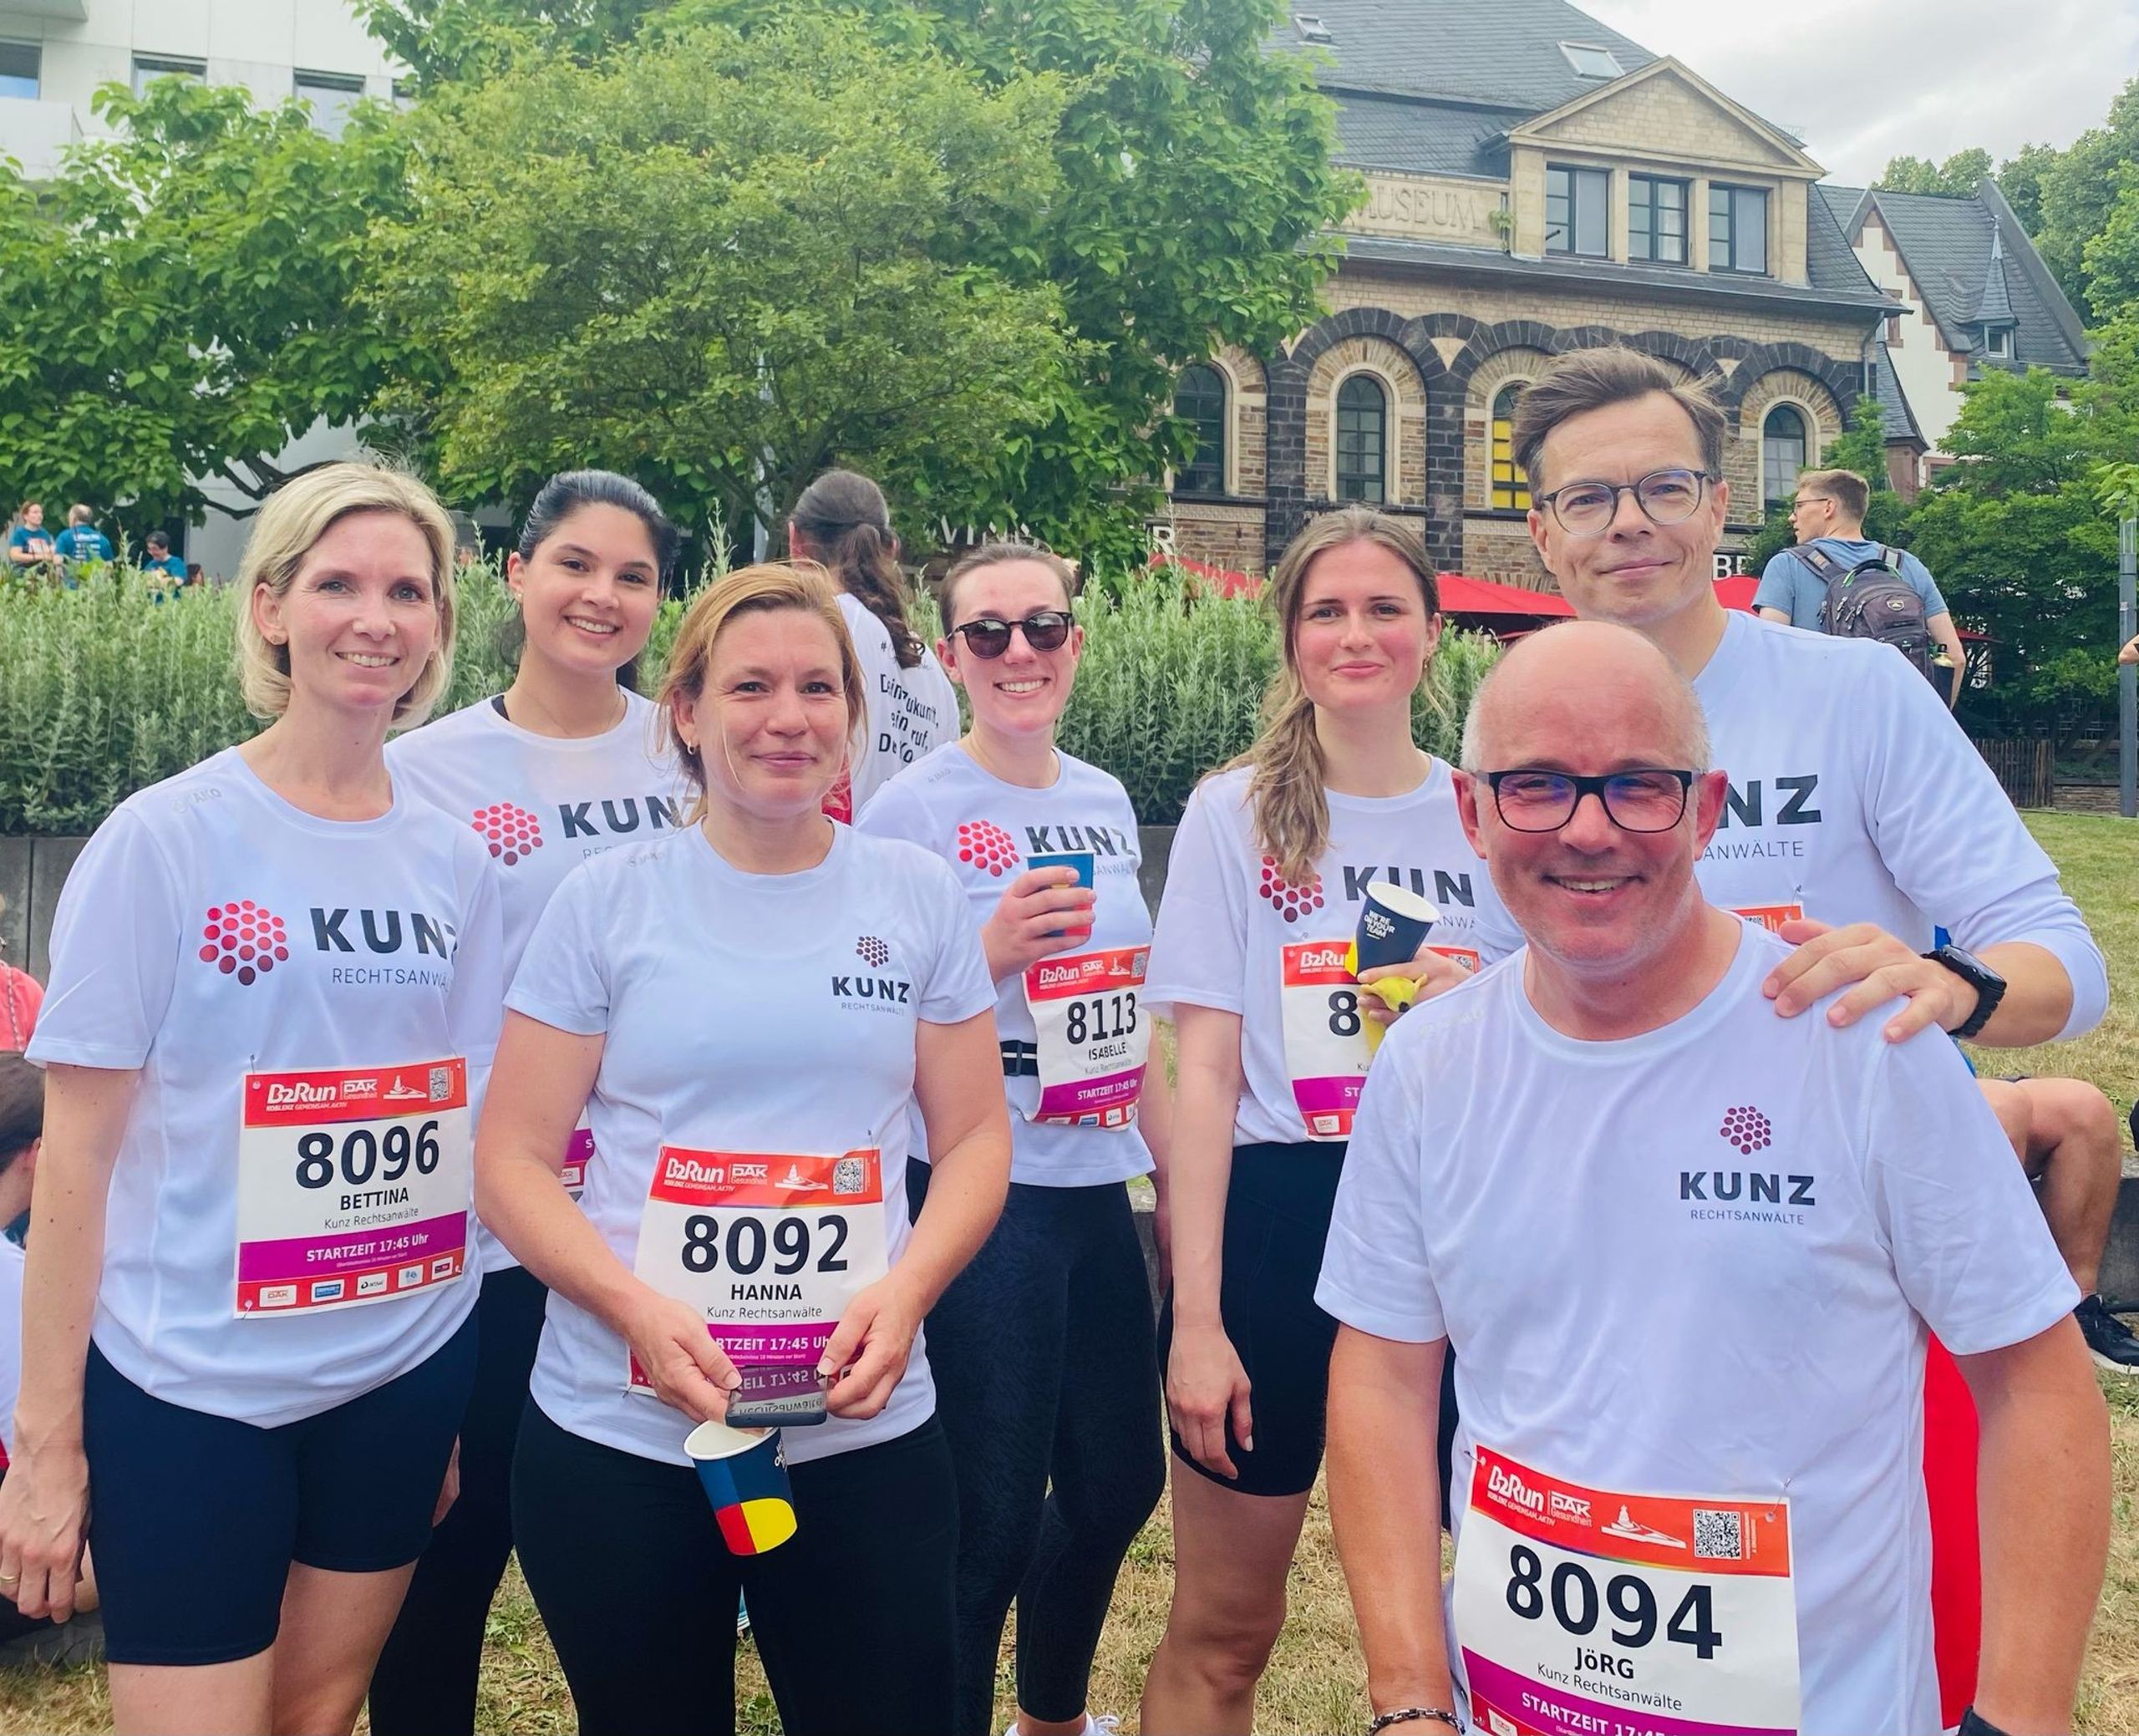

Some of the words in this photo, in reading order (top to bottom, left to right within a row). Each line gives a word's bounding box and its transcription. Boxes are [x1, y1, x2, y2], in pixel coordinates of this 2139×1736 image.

[1718, 774, 1821, 830] NZ
[558, 796, 684, 839] KUN
[1703, 839, 1805, 860] ANWÄLTE
[1343, 865, 1476, 907] KUN
[1300, 949, 1345, 967] B2Ru
[1039, 966, 1080, 984] B2Run
[831, 976, 911, 1003] KUNZ
[1067, 992, 1136, 1045] 8113
[1089, 1042, 1126, 1061] ISABELLE
[1357, 1062, 1369, 1072] Ku
[267, 1082, 337, 1104] B2Run
[343, 1079, 378, 1093] DAK
[1077, 1084, 1114, 1100] STARTZEIT
[296, 1120, 439, 1189] 8096
[665, 1157, 725, 1184] B2Run
[731, 1163, 768, 1177] DAK
[340, 1187, 409, 1211] BETTINA
[1680, 1171, 1815, 1206] KUNZ
[324, 1216, 350, 1229] Kunz
[354, 1208, 419, 1226] Rechtsanwälte
[1690, 1209, 1805, 1226] RECHTSANWÄLTE
[306, 1241, 376, 1262] STARTZEIT
[379, 1236, 409, 1252] 17:45
[412, 1232, 429, 1246] Uhr
[681, 1214, 849, 1276] 8092
[730, 1284, 802, 1301] HANNA
[707, 1307, 735, 1318] Kunz
[739, 1306, 822, 1318] Rechtsanwälte
[716, 1338, 766, 1351] RTZEIT
[770, 1337, 809, 1350] 17:45
[813, 1336, 831, 1349] Uh
[1488, 1464, 1545, 1512] B2Run
[1551, 1490, 1592, 1519] DAK
[1506, 1544, 1723, 1660] 8094
[1574, 1647, 1634, 1679] JöRG
[1537, 1662, 1569, 1686] Kunz
[1573, 1675, 1683, 1711] Rechtsanwälte
[1521, 1691, 1609, 1736] STARTZEIT
[1614, 1723, 1665, 1736] 17:
